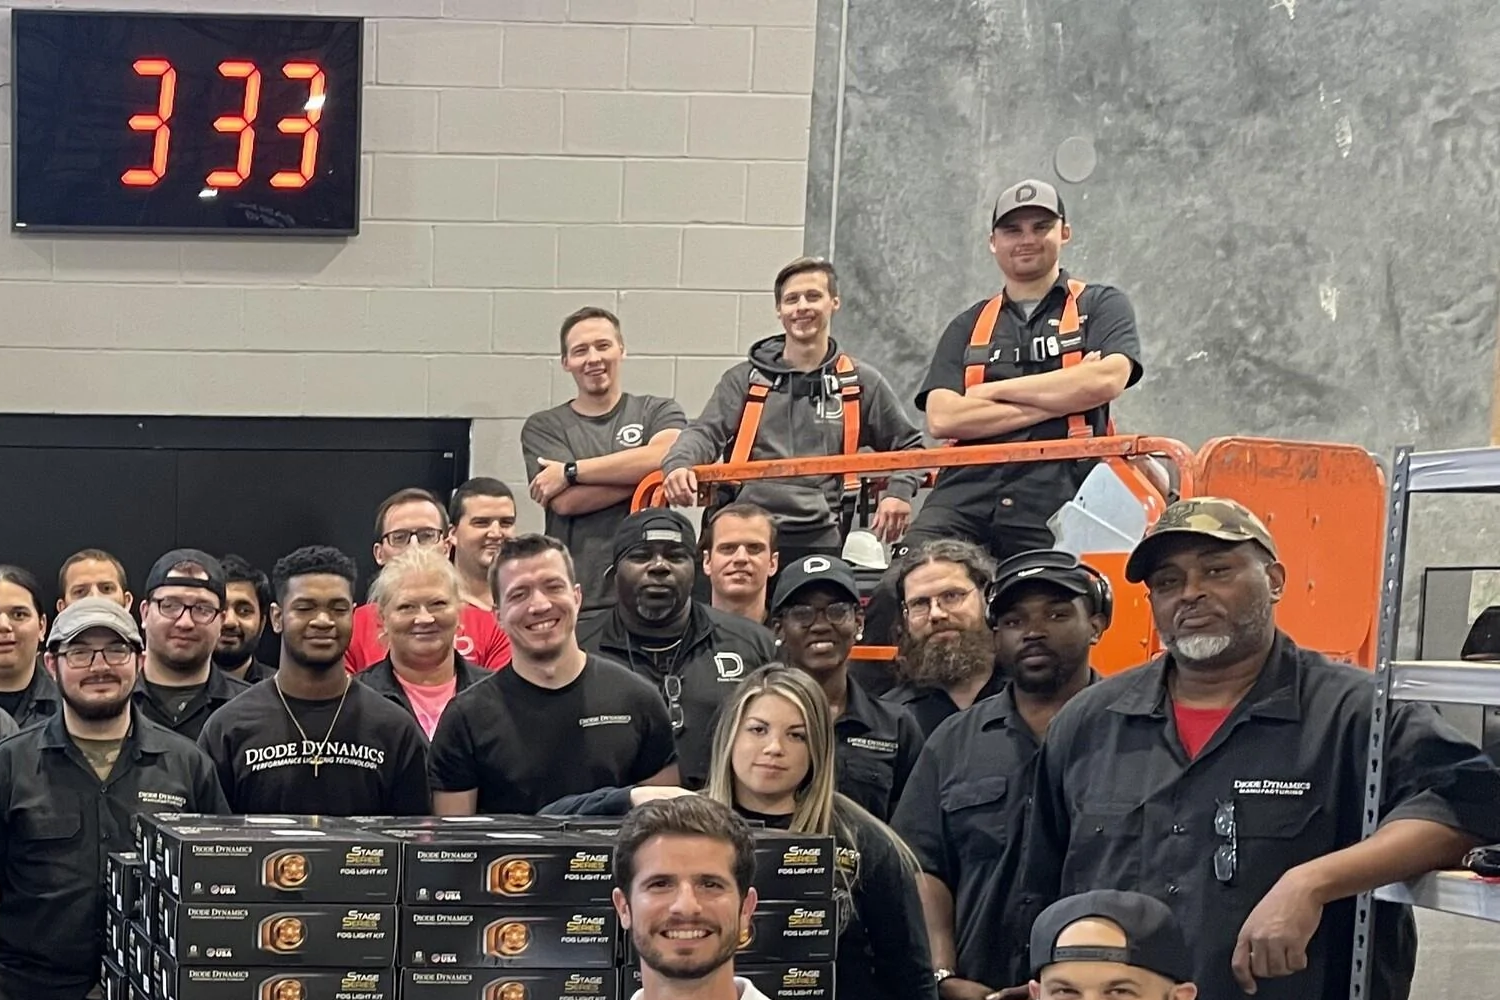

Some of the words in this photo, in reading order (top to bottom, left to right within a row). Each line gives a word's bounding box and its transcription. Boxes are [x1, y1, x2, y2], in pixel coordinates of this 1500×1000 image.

[245, 743, 296, 766] DIODE
[302, 740, 384, 764] DYNAMICS
[252, 756, 301, 772] PERFORMANCE
[1263, 780, 1311, 790] DYNAMICS
[351, 847, 384, 856] STAGE
[789, 846, 821, 856] STAGE
[575, 852, 608, 862] STAGE
[348, 911, 380, 920] STAGE
[794, 908, 825, 918] STAGE
[572, 915, 605, 925] STAGE
[347, 972, 379, 982] STAGE
[788, 968, 820, 978] STAGE
[570, 975, 602, 984] STAGE
